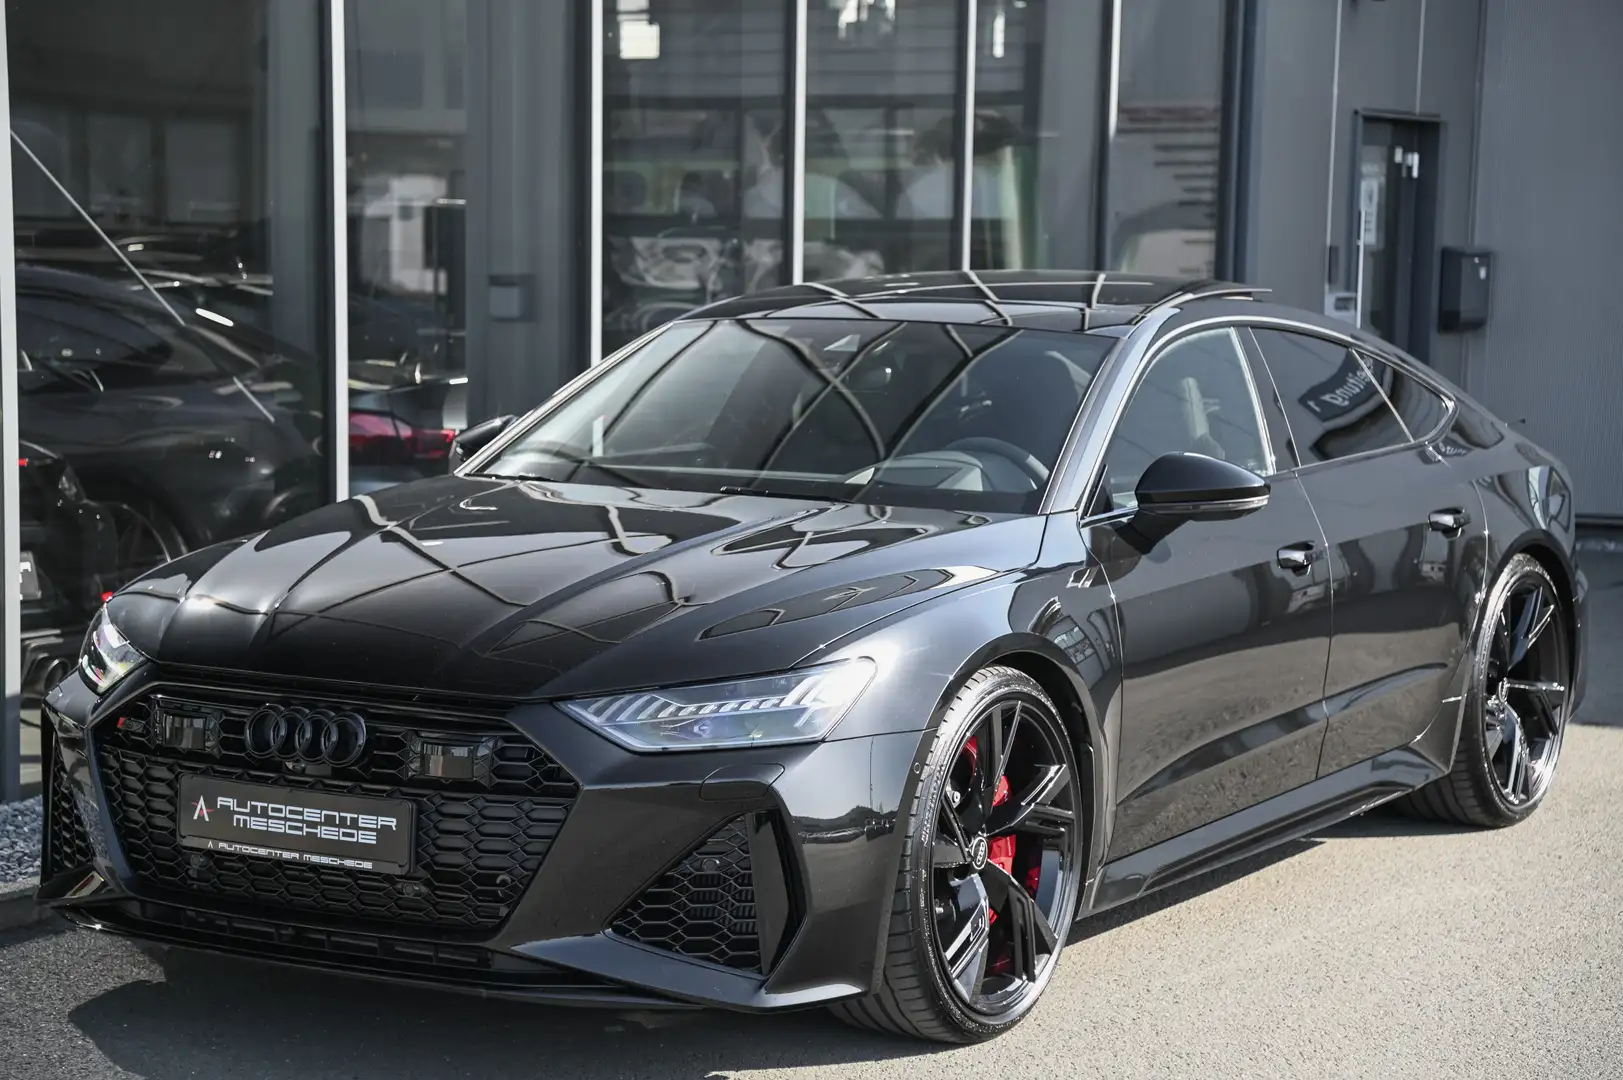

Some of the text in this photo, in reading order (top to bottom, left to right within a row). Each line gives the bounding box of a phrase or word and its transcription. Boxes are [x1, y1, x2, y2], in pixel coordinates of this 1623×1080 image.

[217, 796, 397, 831] AUTOCENTER
[233, 814, 377, 845] MESCHEDE
[218, 842, 300, 860] AUTOCENTER
[303, 854, 373, 869] MESCHEDE
